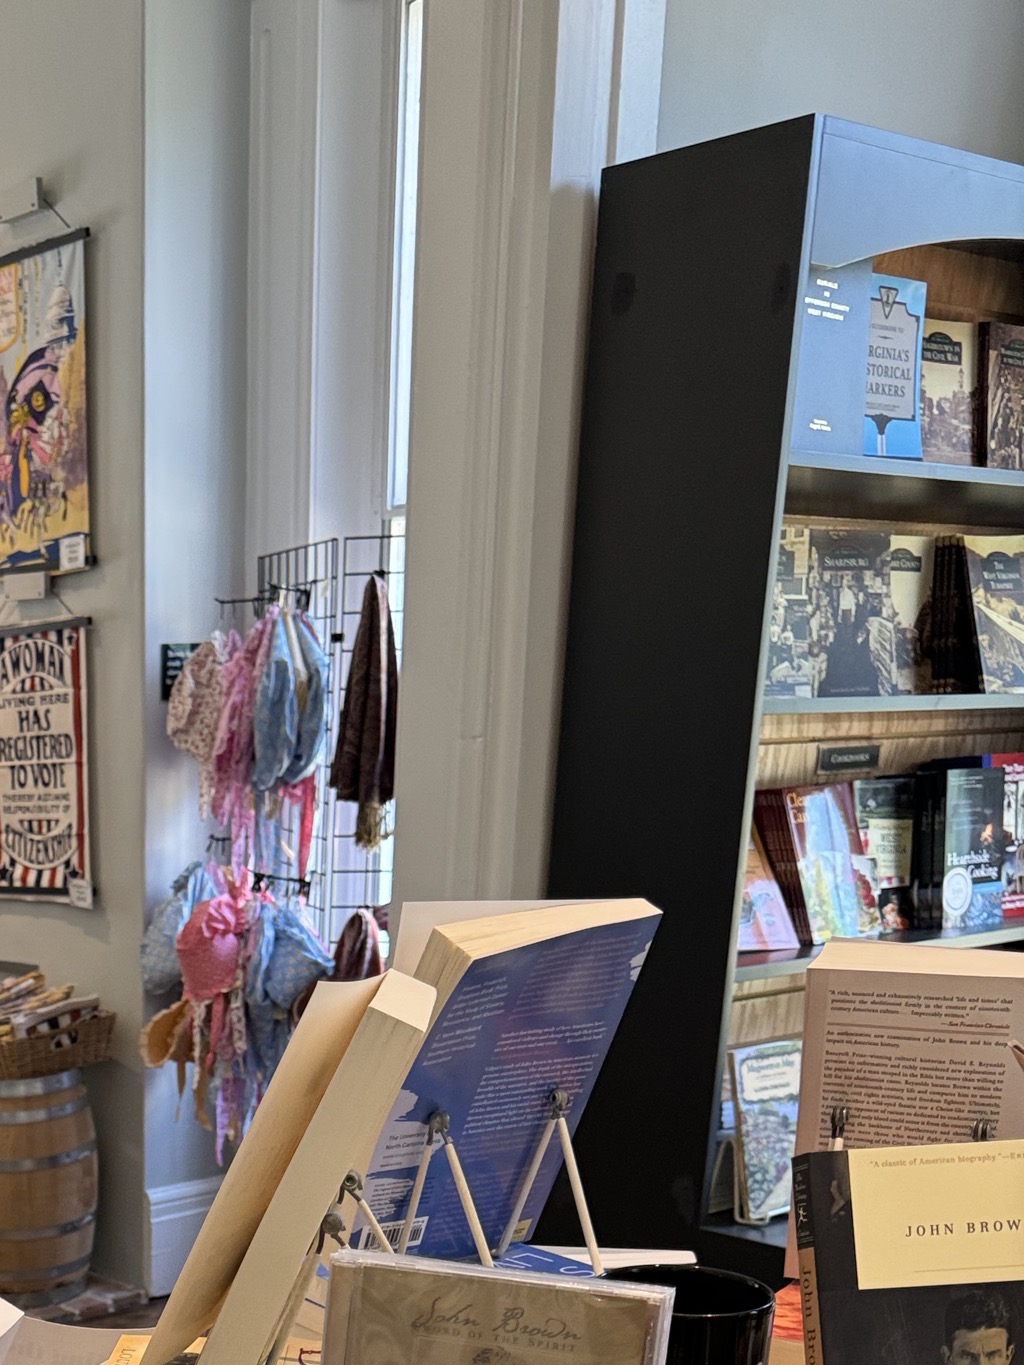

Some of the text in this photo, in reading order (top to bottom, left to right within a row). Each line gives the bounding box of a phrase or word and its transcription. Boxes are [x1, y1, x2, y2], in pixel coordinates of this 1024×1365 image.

[869, 345, 910, 362] RGINIA'S
[867, 363, 911, 380] STORICAL
[0, 641, 67, 691] A WOMAN
[40, 693, 69, 705] HERE
[18, 708, 51, 733] HAS
[9, 763, 66, 790] TO VOTE
[4, 822, 73, 865] CITIZENSHIP
[967, 864, 998, 880] Cooking
[881, 1159, 907, 1167] classic
[909, 1158, 917, 1166] of
[919, 1157, 955, 1165] American
[905, 1219, 1022, 1238] JOHN BROW
[802, 1267, 812, 1319] John
[411, 1296, 581, 1340] John Brown
[493, 1334, 520, 1345] THE
[529, 1339, 576, 1352] SPIRIT
